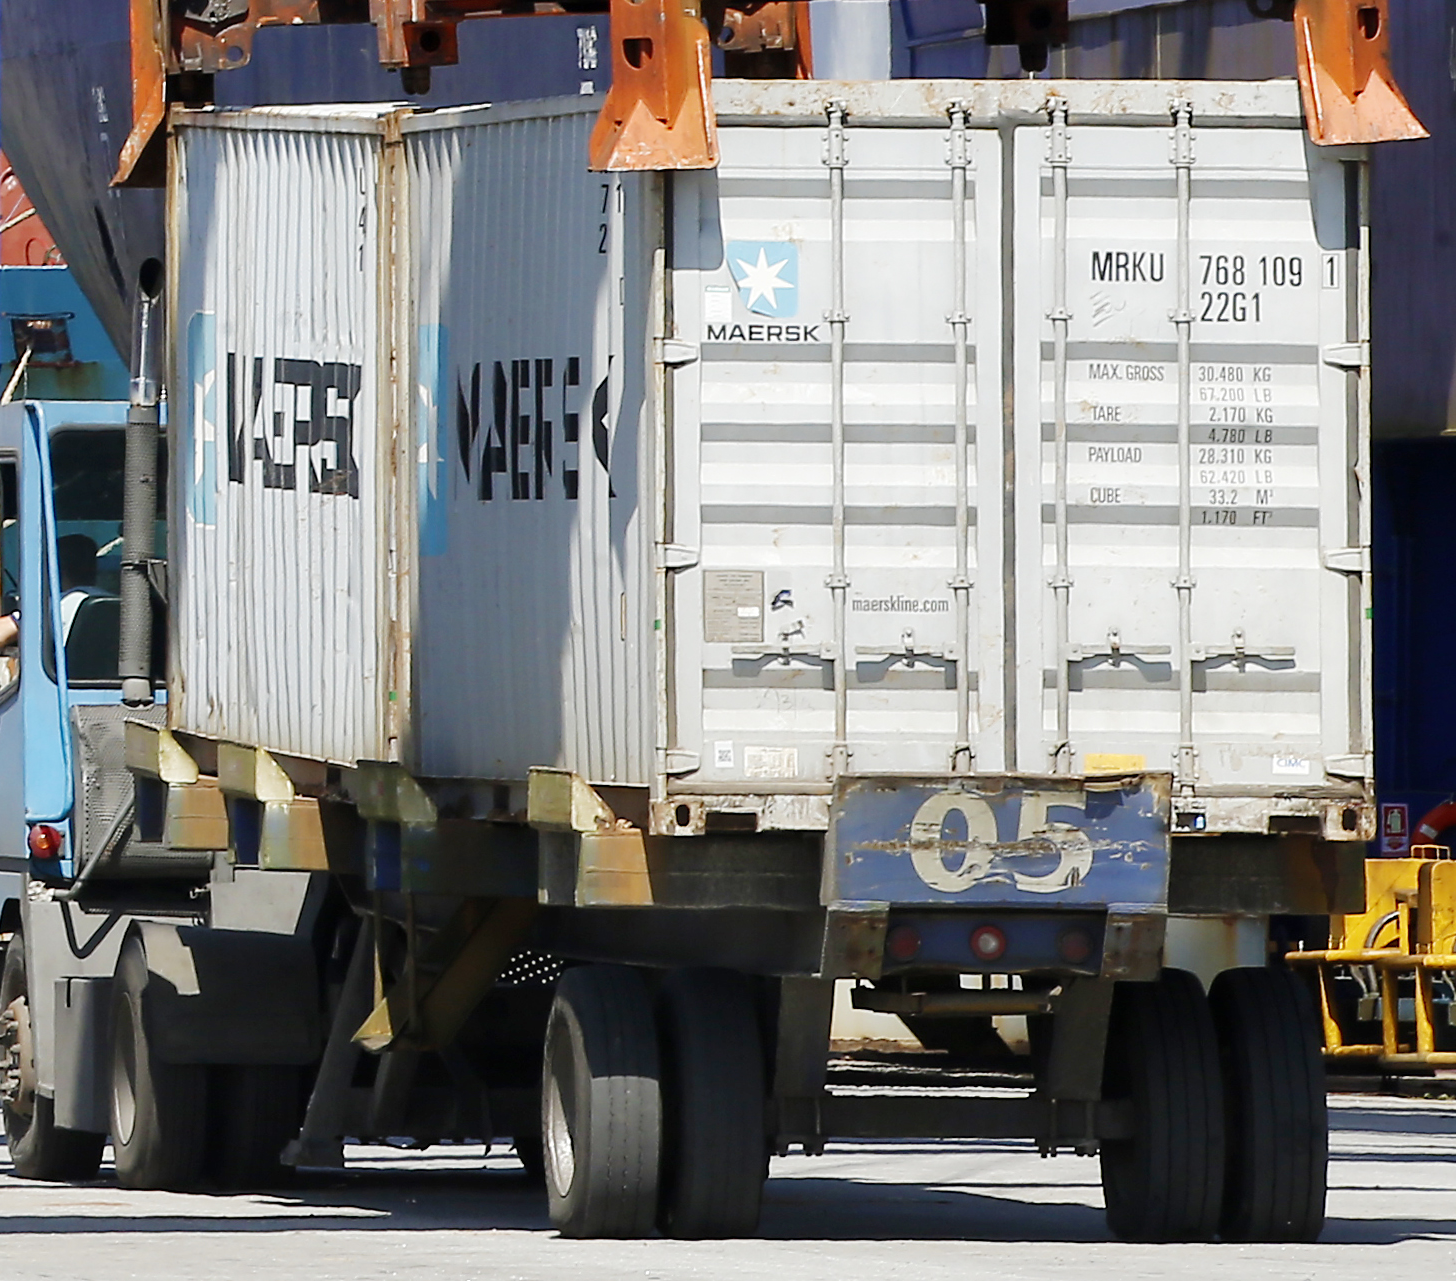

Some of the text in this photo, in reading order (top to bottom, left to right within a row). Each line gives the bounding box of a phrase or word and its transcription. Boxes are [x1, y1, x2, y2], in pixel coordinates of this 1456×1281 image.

[1090, 252, 1335, 287] MRKU 768 109 1
[1200, 292, 1261, 322] 22G1
[706, 324, 820, 342] MAERSK
[1089, 364, 1271, 382] MAX. GROSS 30.480 KG
[1199, 388, 1271, 403] 67.200 LB
[1092, 406, 1273, 423] TARE 2.170 KG
[1208, 428, 1273, 443] 4.780 LB
[1088, 447, 1272, 464] PAYLOAD 28.310 KG
[1200, 469, 1273, 484] 62.420 LB
[1090, 487, 1121, 504] CUBE
[1209, 489, 1238, 505] 33.2
[1201, 510, 1237, 525] 1.170
[851, 597, 950, 614] maerskline.com
[1276, 758, 1307, 768] CIMC
[909, 788, 1095, 894] 05
